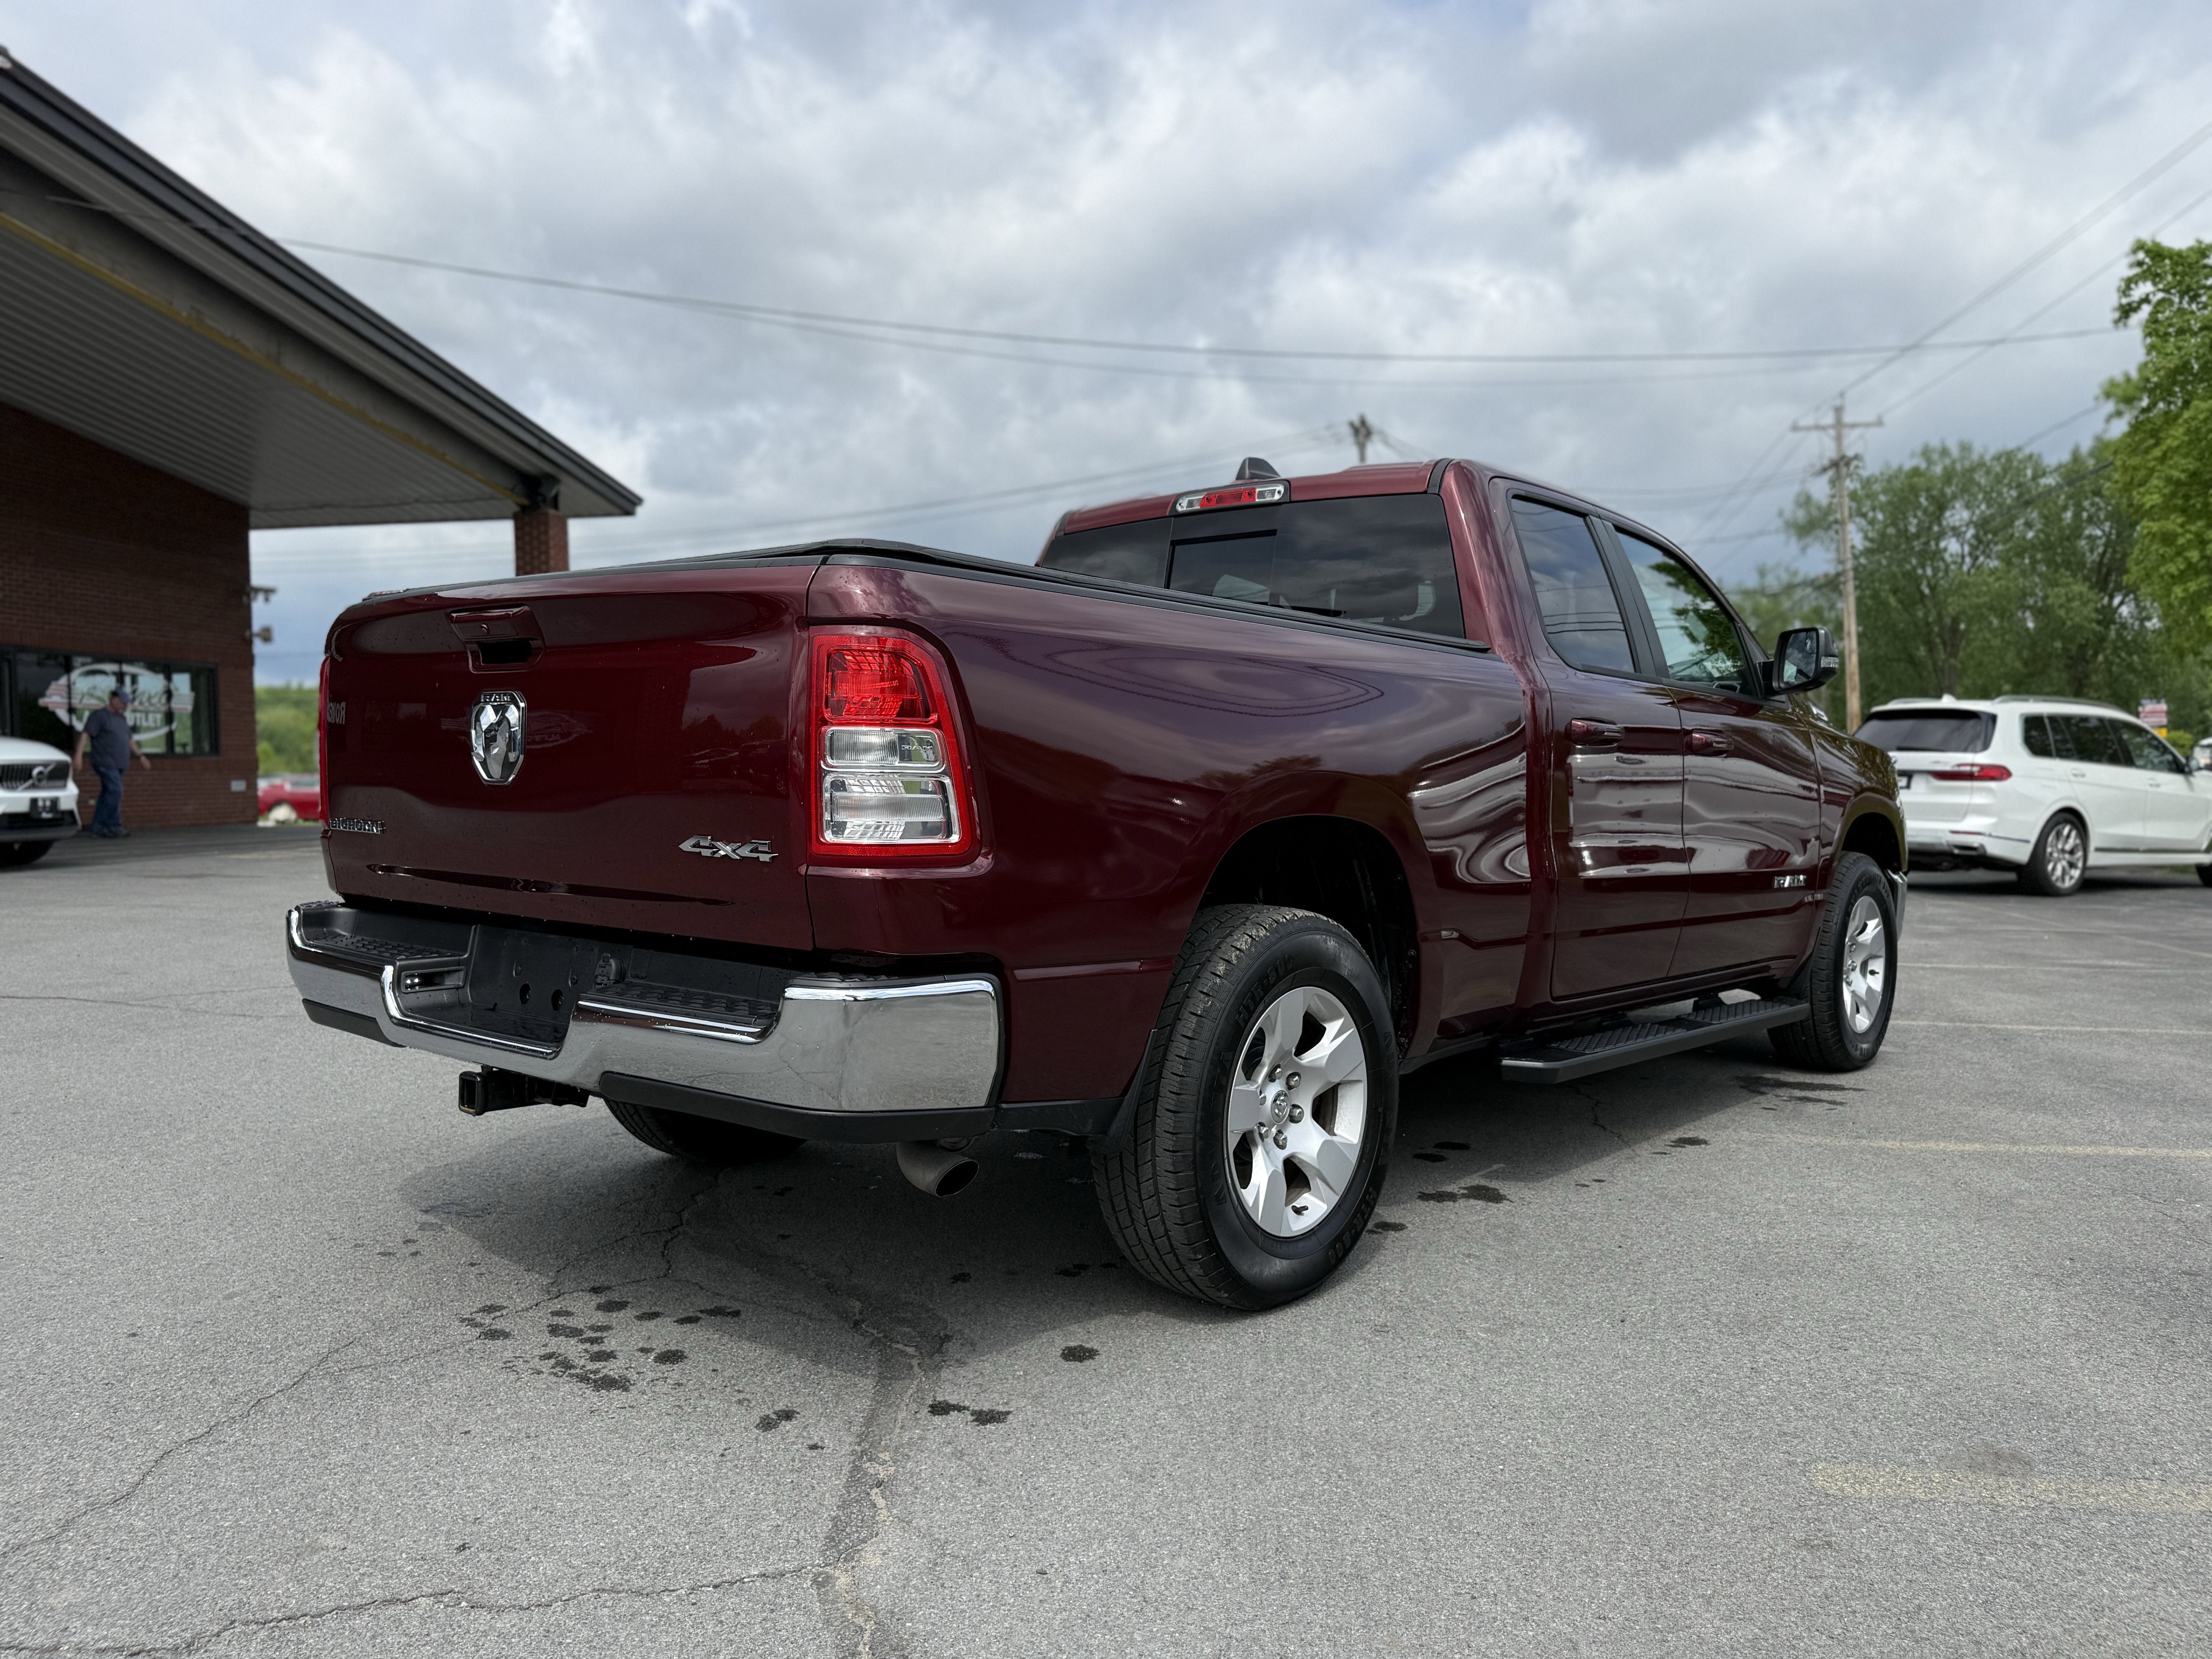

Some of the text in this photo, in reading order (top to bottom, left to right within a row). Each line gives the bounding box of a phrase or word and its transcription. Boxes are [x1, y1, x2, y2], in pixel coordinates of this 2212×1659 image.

[481, 693, 512, 702] RAM
[125, 712, 161, 726] UTLET
[1772, 874, 1807, 888] RAM
[1234, 953, 1294, 1029] HTR-800
